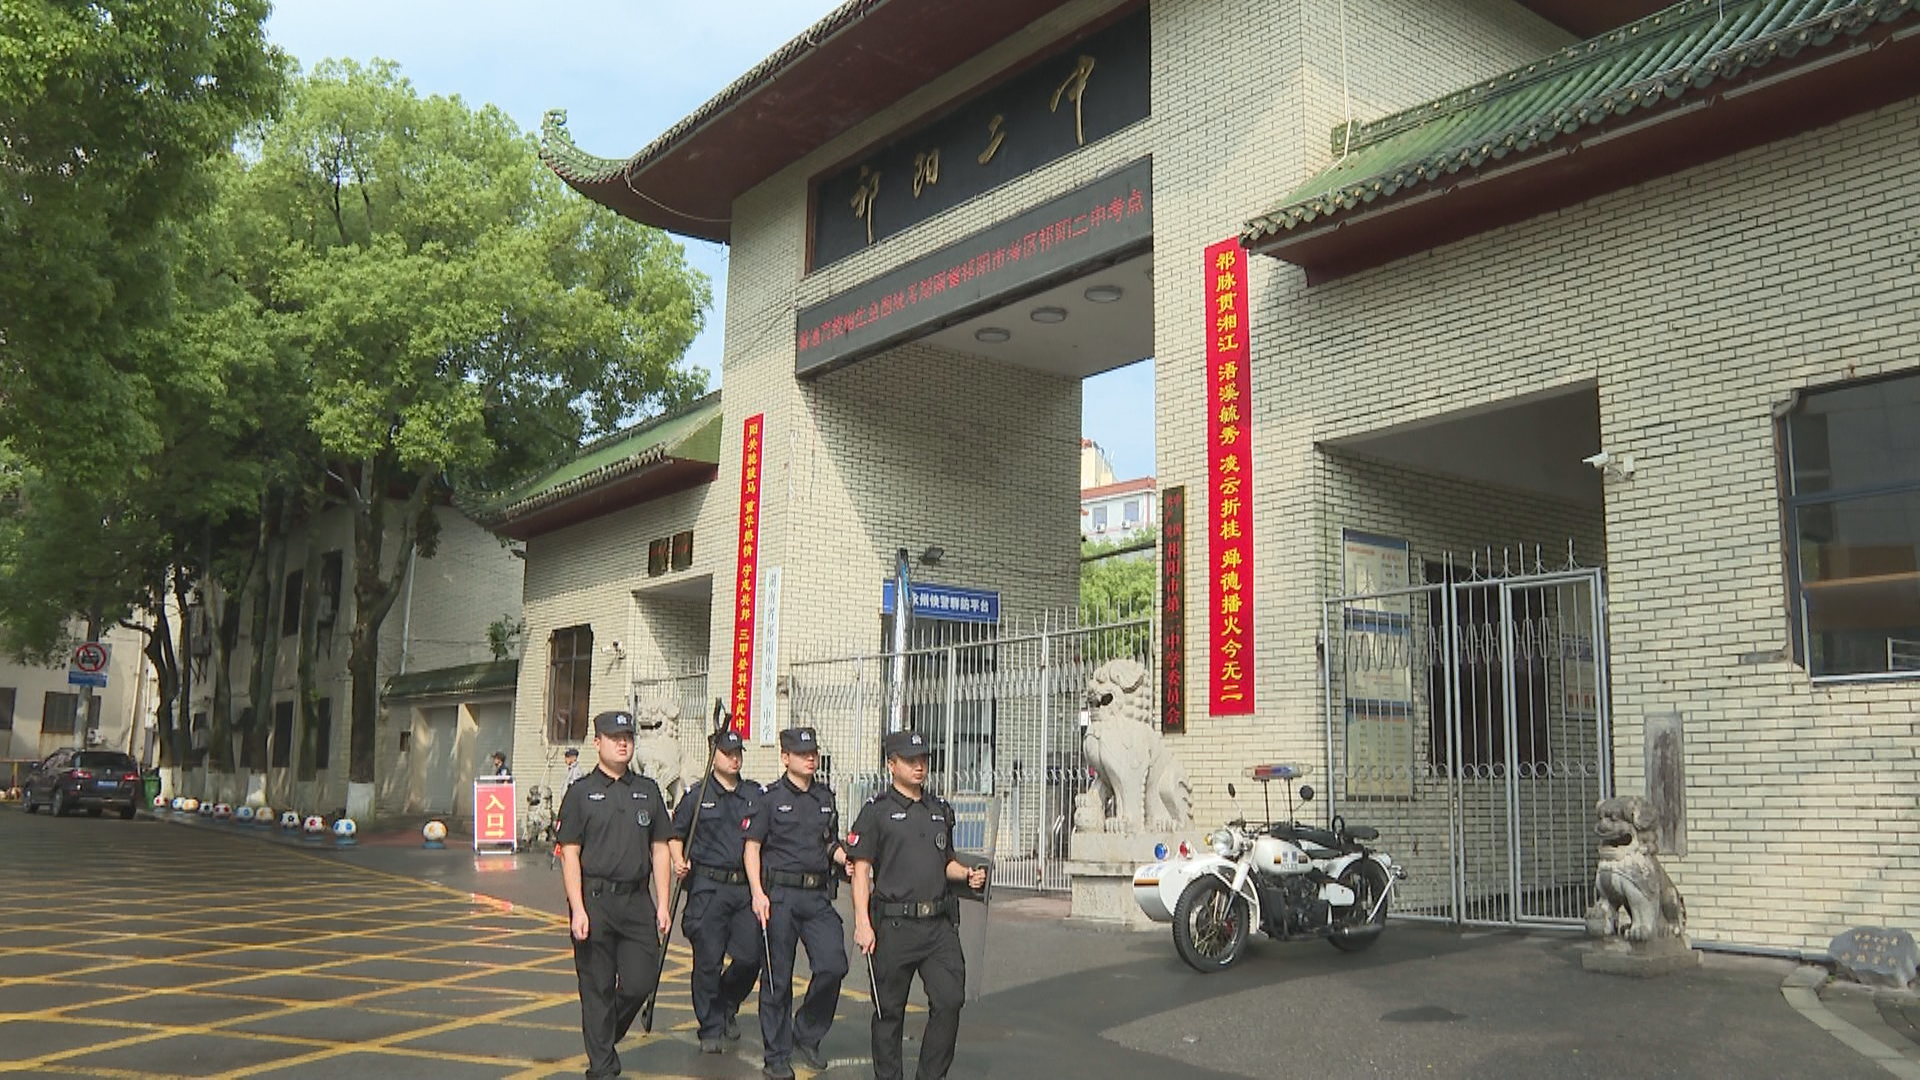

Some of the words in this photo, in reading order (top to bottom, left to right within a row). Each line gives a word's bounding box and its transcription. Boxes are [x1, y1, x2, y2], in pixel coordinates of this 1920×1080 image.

[1216, 250, 1239, 352] 祁脉贯湘江
[1218, 361, 1241, 446] 浯溪毓秀
[1219, 453, 1242, 540] 凌云折桂
[1220, 547, 1243, 702] 舜德播火今无二
[485, 794, 506, 829] 入口
